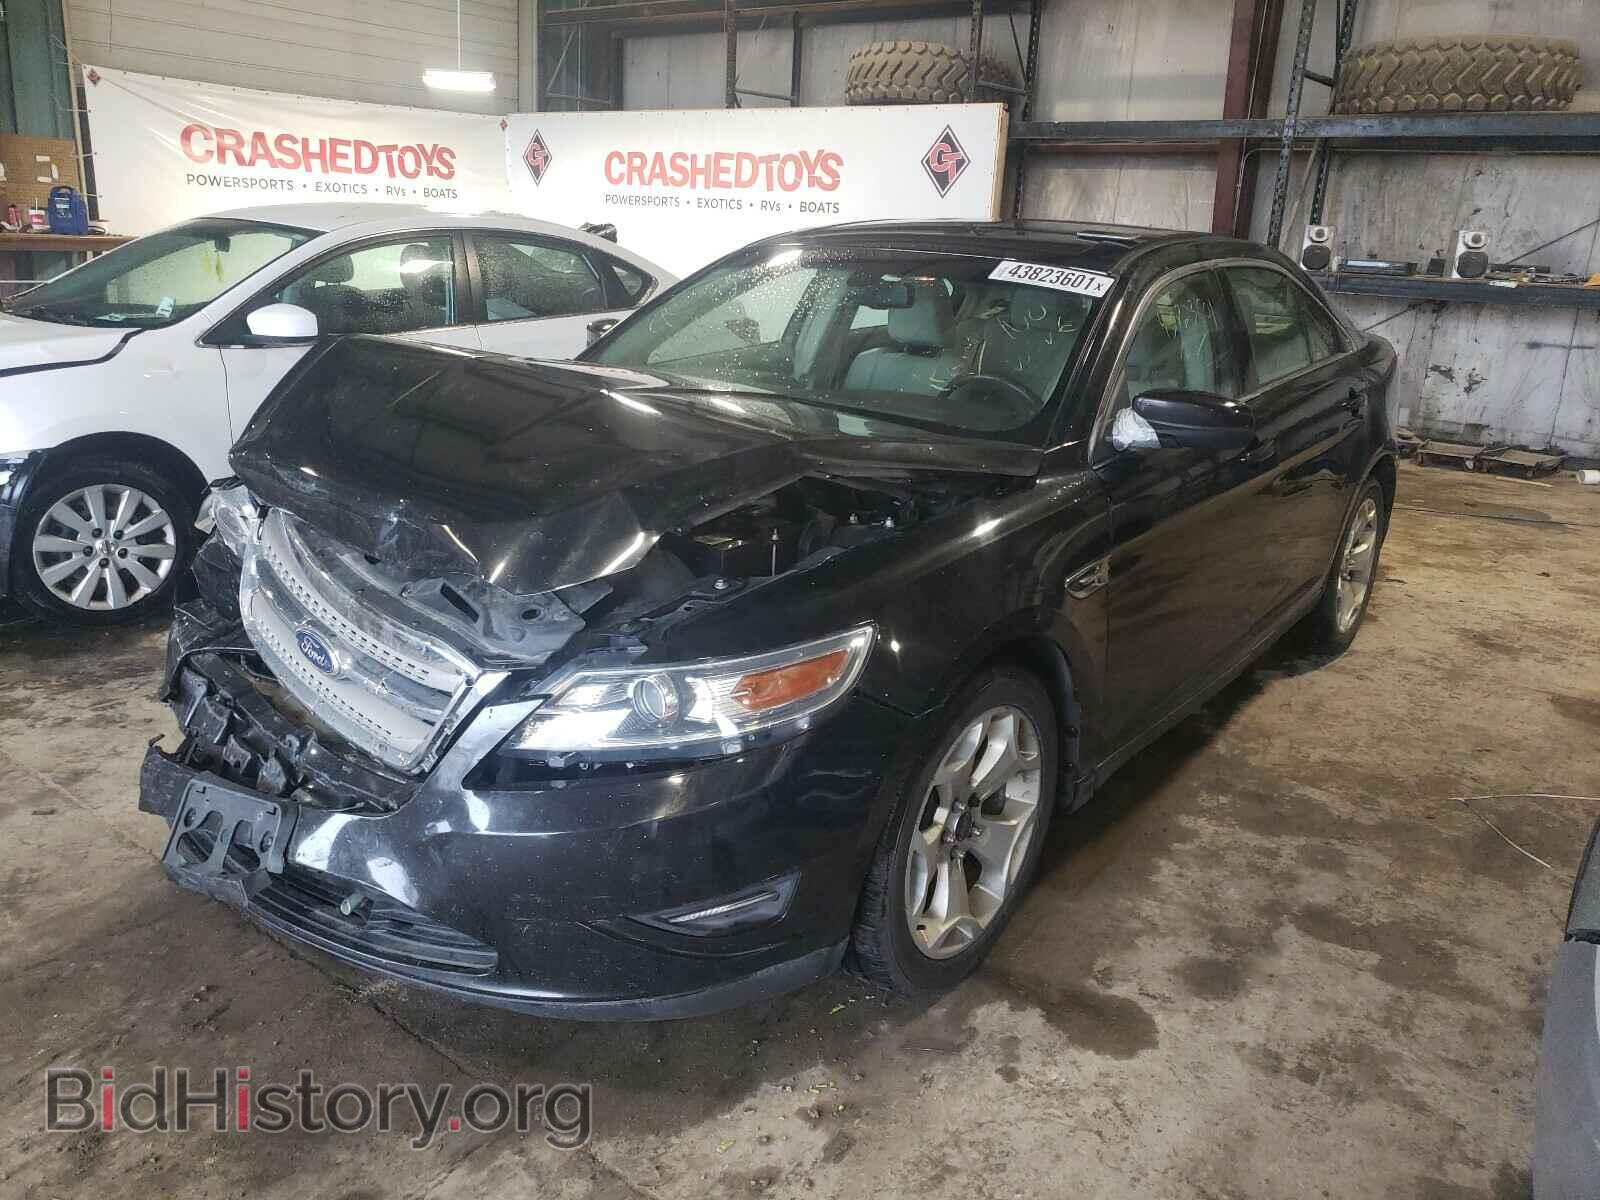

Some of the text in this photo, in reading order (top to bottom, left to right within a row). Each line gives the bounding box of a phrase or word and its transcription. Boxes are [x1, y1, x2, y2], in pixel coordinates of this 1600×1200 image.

[179, 122, 458, 181] CRASHEDTOYS
[604, 149, 844, 192] CRASHEDTOYS
[186, 173, 458, 199] POWERSPORTS EXOTICS RVs BOATS
[605, 194, 840, 214] POWERSPORTS EXOTICS RVs BOATS
[1008, 264, 1096, 290] 43823601
[301, 636, 326, 666] Ford
